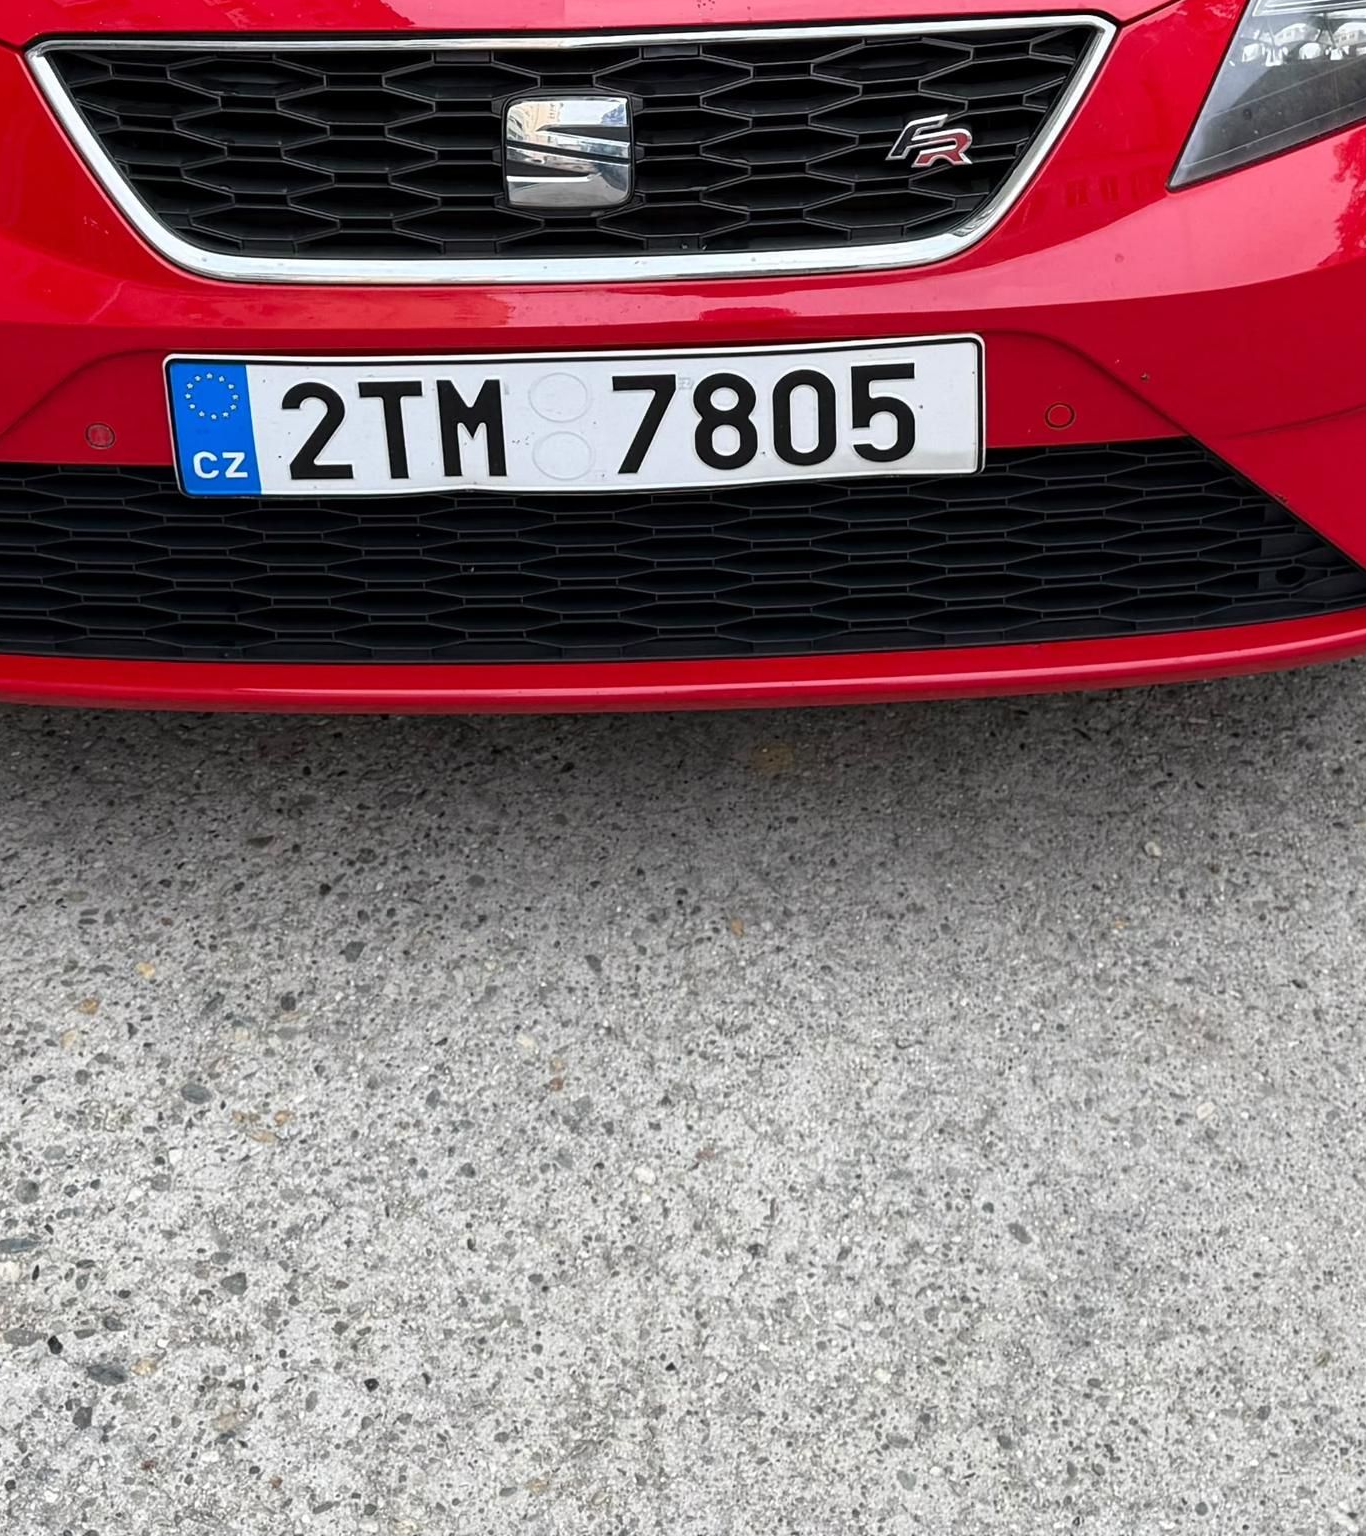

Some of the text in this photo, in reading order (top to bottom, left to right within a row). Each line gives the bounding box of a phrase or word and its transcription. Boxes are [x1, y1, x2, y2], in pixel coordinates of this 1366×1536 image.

[884, 113, 973, 169] FR
[281, 362, 917, 481] 2TM 7805
[192, 450, 249, 480] CZ
